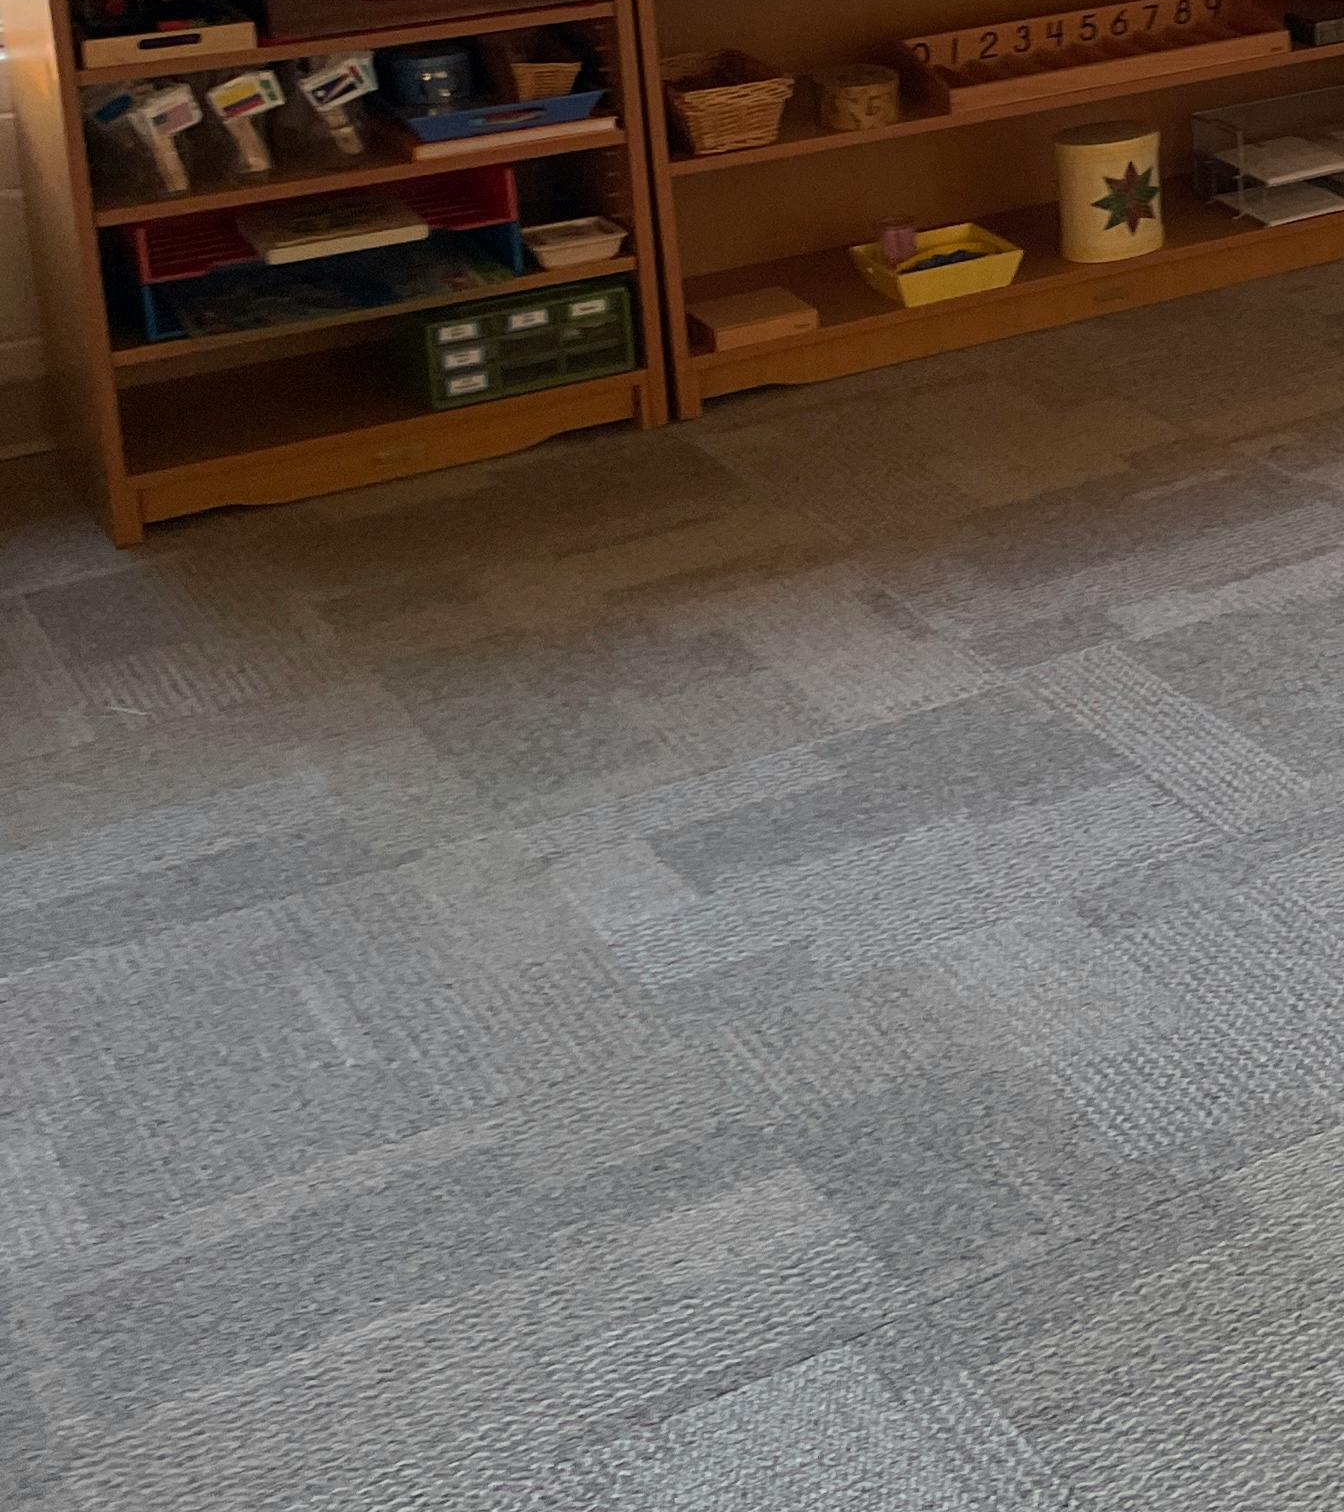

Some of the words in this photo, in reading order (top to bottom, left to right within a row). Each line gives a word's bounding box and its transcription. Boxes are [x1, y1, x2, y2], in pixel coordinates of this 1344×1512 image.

[980, 32, 999, 59] 2
[1014, 25, 1031, 53] 3
[1047, 20, 1063, 46] 4
[1079, 14, 1098, 41] 5
[1111, 10, 1130, 36] 6
[1142, 4, 1159, 31] 7
